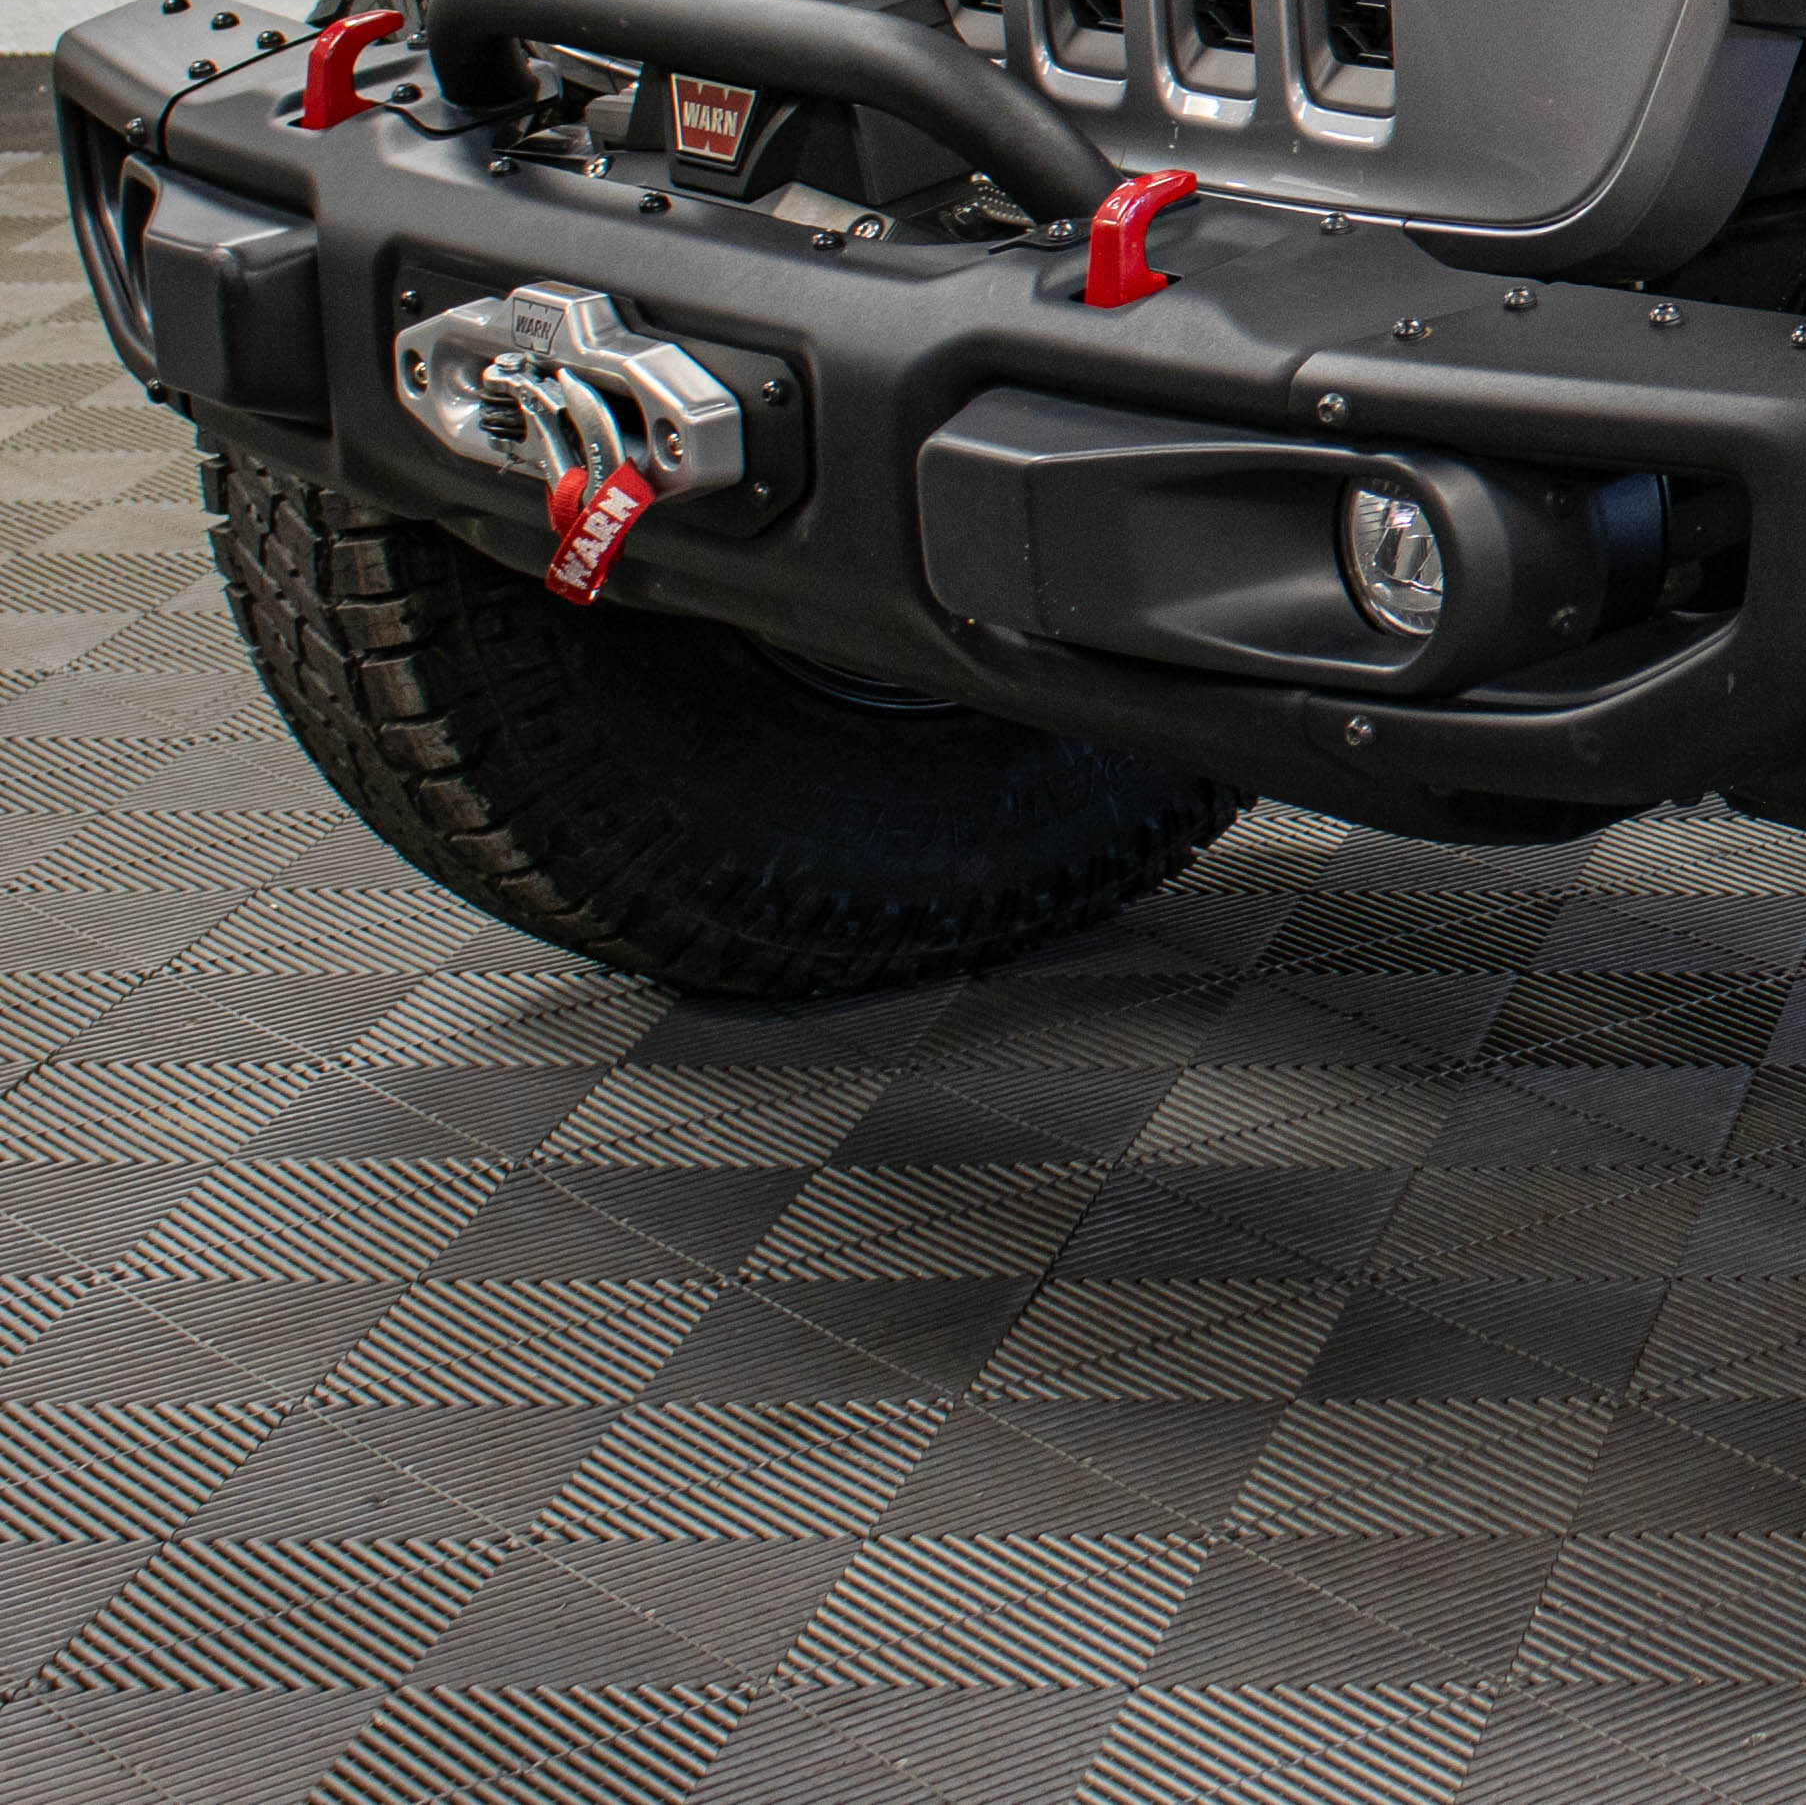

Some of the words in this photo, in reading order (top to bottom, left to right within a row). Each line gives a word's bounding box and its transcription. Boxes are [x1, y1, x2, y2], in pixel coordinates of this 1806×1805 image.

[683, 100, 738, 138] WARN
[515, 314, 552, 340] WARN
[550, 486, 639, 590] WARN
